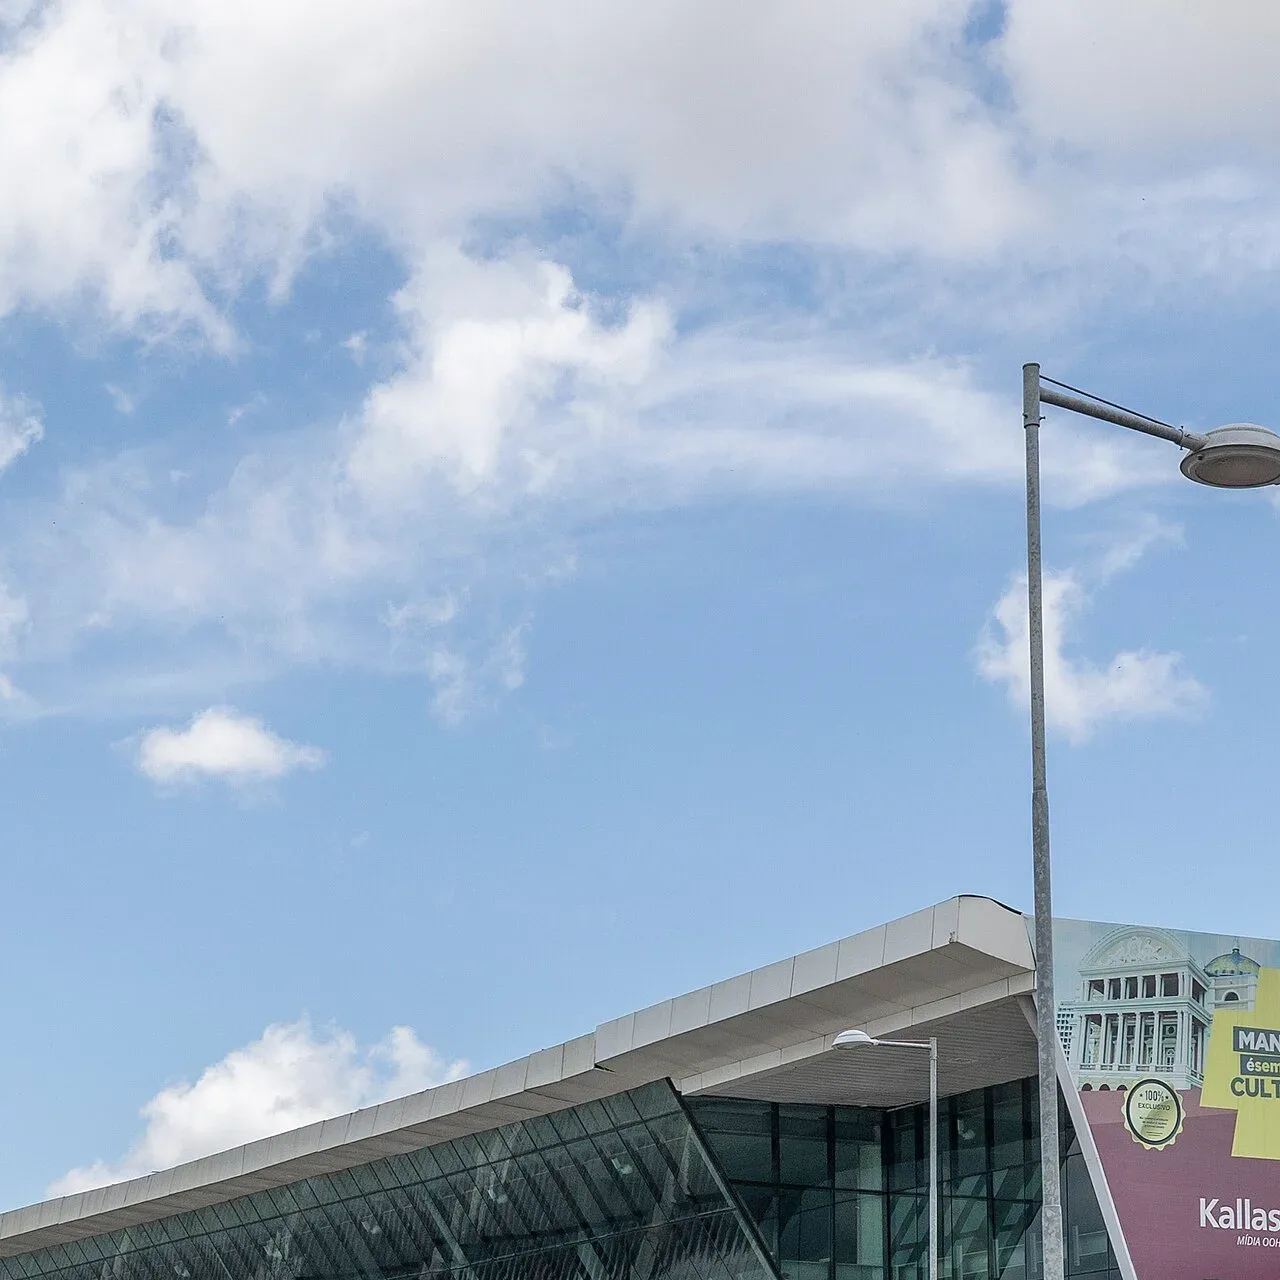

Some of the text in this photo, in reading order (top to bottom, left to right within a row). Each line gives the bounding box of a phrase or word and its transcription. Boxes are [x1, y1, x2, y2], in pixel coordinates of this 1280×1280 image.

[1145, 1090, 1165, 1102] 100%
[1137, 1102, 1171, 1111] EXCLUSIVO
[1236, 1234, 1261, 1247] MÍDIA
